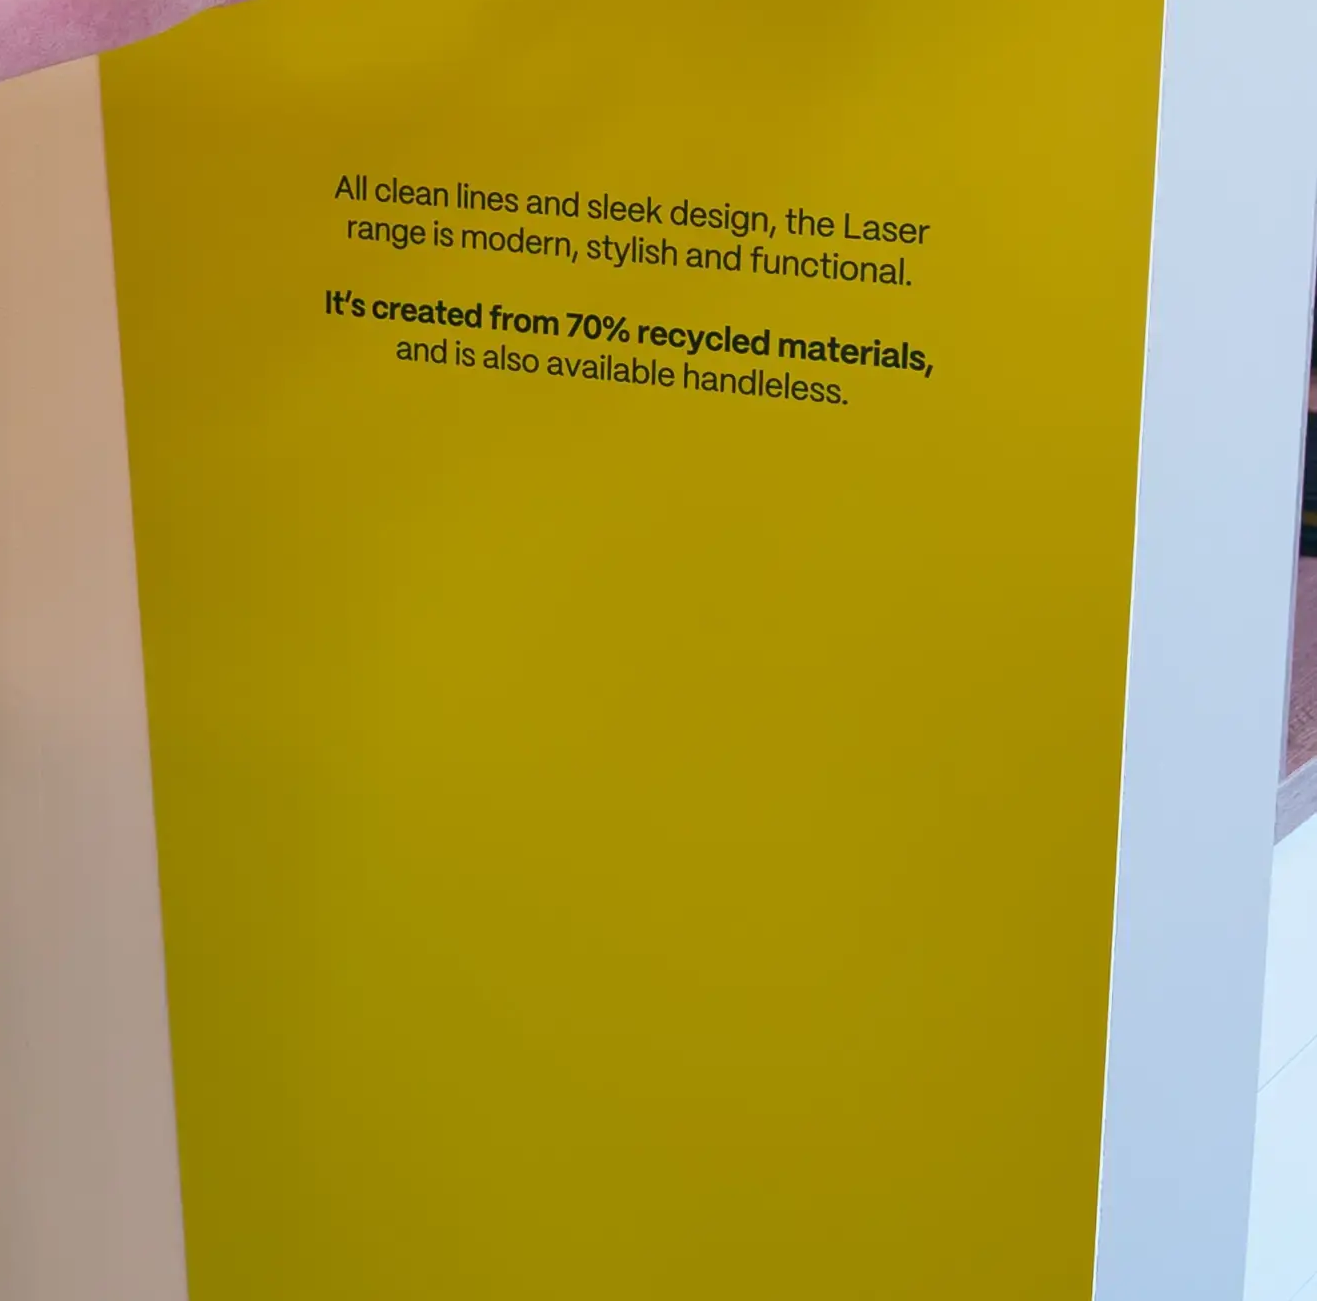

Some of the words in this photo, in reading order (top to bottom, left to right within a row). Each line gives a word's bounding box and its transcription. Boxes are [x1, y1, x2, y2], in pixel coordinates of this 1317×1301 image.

[334, 174, 367, 201] All
[374, 177, 449, 208] clean
[457, 182, 519, 213] lines
[526, 191, 580, 218] and
[587, 193, 663, 224] sleek
[670, 199, 776, 239] design,
[785, 207, 835, 238] the
[844, 212, 931, 245] Laser
[347, 220, 426, 250] range
[433, 220, 454, 248] is
[461, 226, 579, 264] modern,
[586, 234, 678, 268] stylish
[685, 244, 742, 272] and
[750, 245, 912, 287] functional.
[371, 299, 483, 330] created
[489, 304, 560, 336] from
[566, 312, 630, 343] 70%
[637, 325, 771, 356] recycled
[778, 336, 934, 379] materials,
[396, 338, 447, 365] and
[455, 340, 476, 367] is
[482, 344, 540, 374] also
[546, 354, 675, 388] available
[683, 361, 848, 405] handleless.
